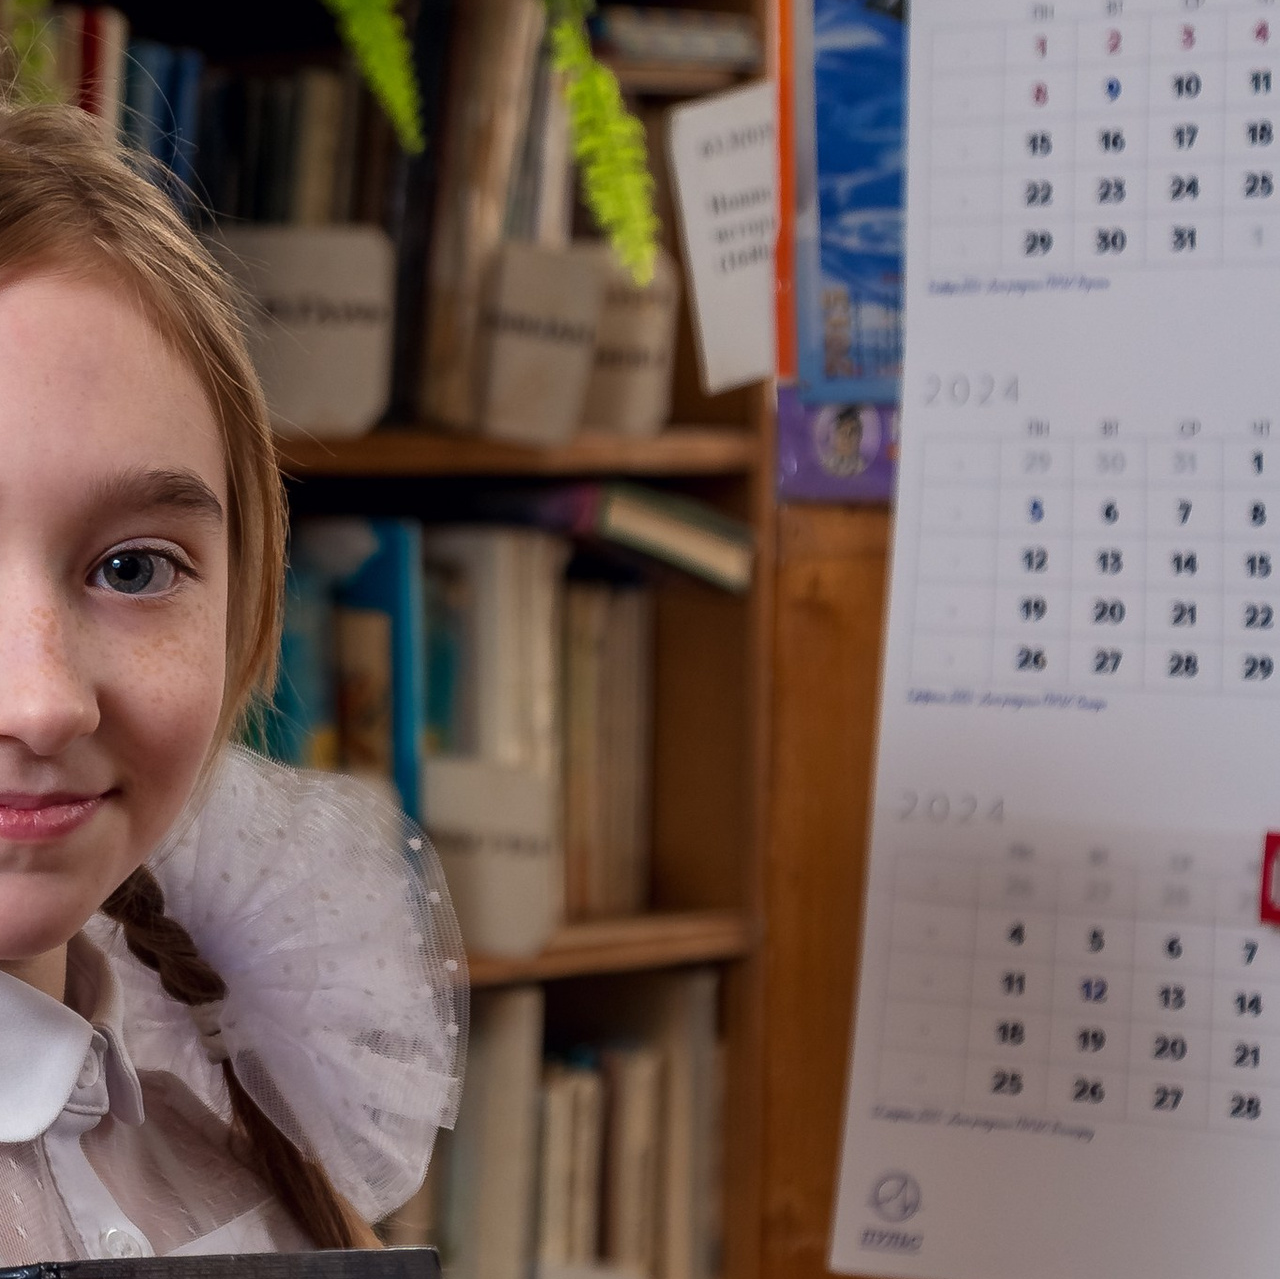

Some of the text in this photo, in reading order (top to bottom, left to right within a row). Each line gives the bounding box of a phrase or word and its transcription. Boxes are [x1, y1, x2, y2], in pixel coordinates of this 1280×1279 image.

[1172, 73, 1203, 98] 10
[1249, 70, 1273, 94] 11
[1026, 120, 1274, 157] 15 16 17 18
[1024, 172, 1275, 207] 22 23 24 25
[1023, 230, 1054, 257] 29
[1095, 228, 1128, 254] 30
[1171, 225, 1198, 252] 31
[924, 372, 1020, 407] 2024
[1251, 451, 1265, 475] 1
[1101, 501, 1120, 524] 6
[1177, 499, 1194, 525] 7
[1249, 501, 1268, 527] 8
[1021, 547, 1273, 579] 12 13 14 15
[1019, 597, 1275, 630] 19 20 21 22
[1016, 646, 1275, 681] 26 27 28 29
[1164, 936, 1184, 960] 6
[1242, 940, 1259, 966] 7
[1001, 971, 1264, 1017] 11 12 13 14
[995, 1020, 1261, 1069] 18 19 20 21
[990, 1069, 1262, 1121] 25 26 27 28
